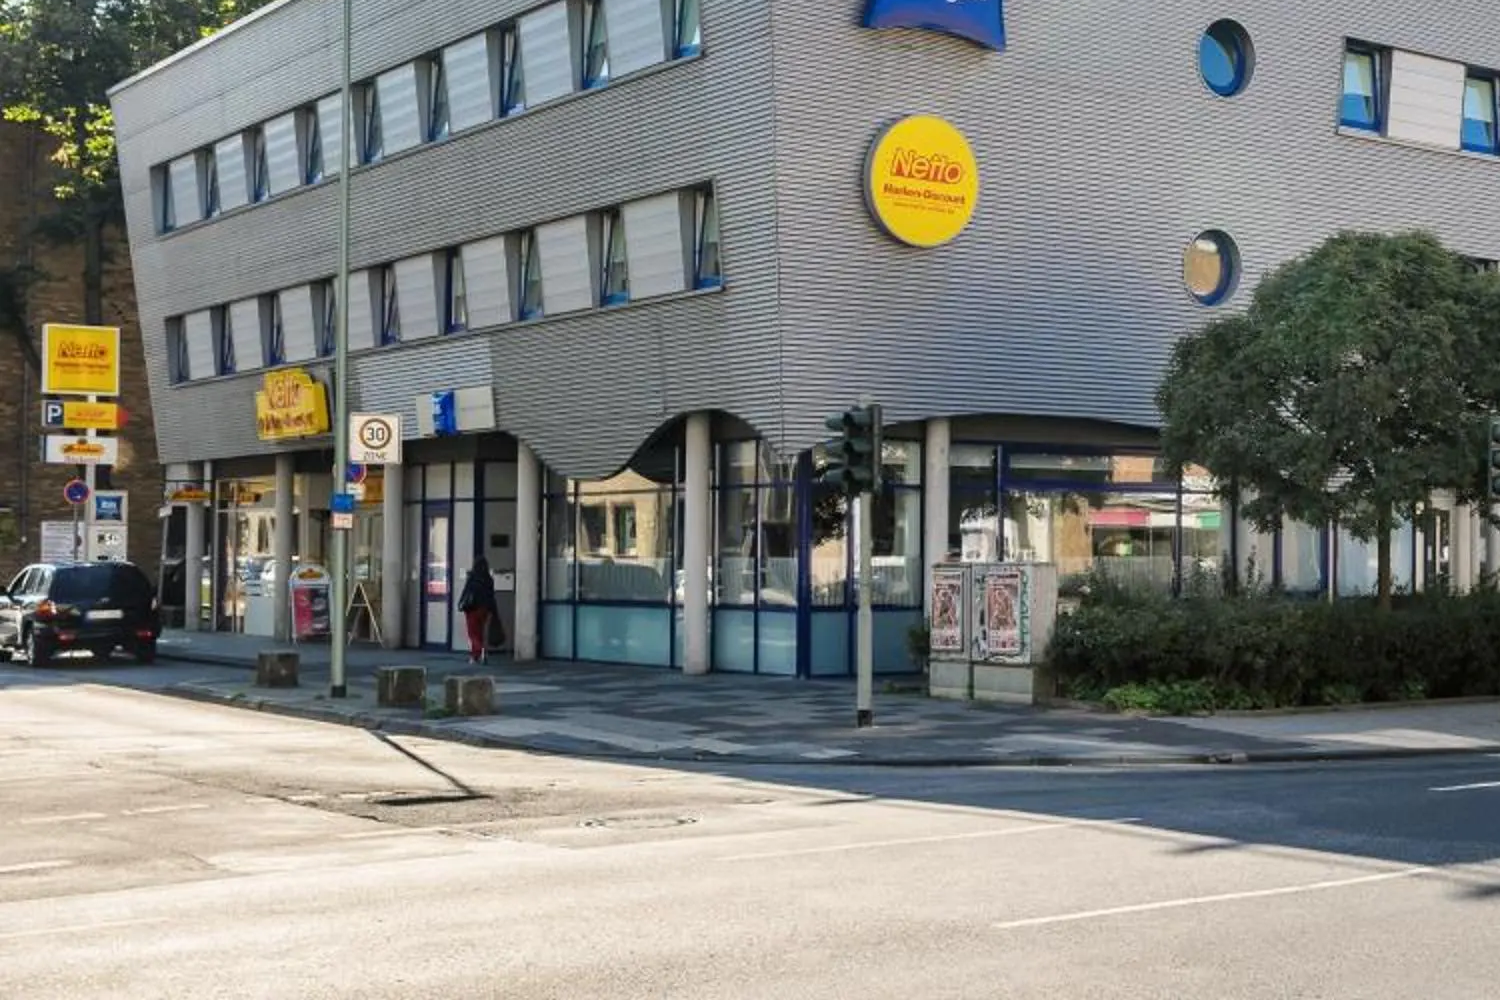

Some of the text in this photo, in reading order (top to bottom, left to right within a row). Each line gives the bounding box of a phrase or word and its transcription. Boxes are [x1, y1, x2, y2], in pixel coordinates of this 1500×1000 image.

[890, 147, 968, 185] Netto
[47, 405, 63, 424] P
[366, 427, 385, 441] 30
